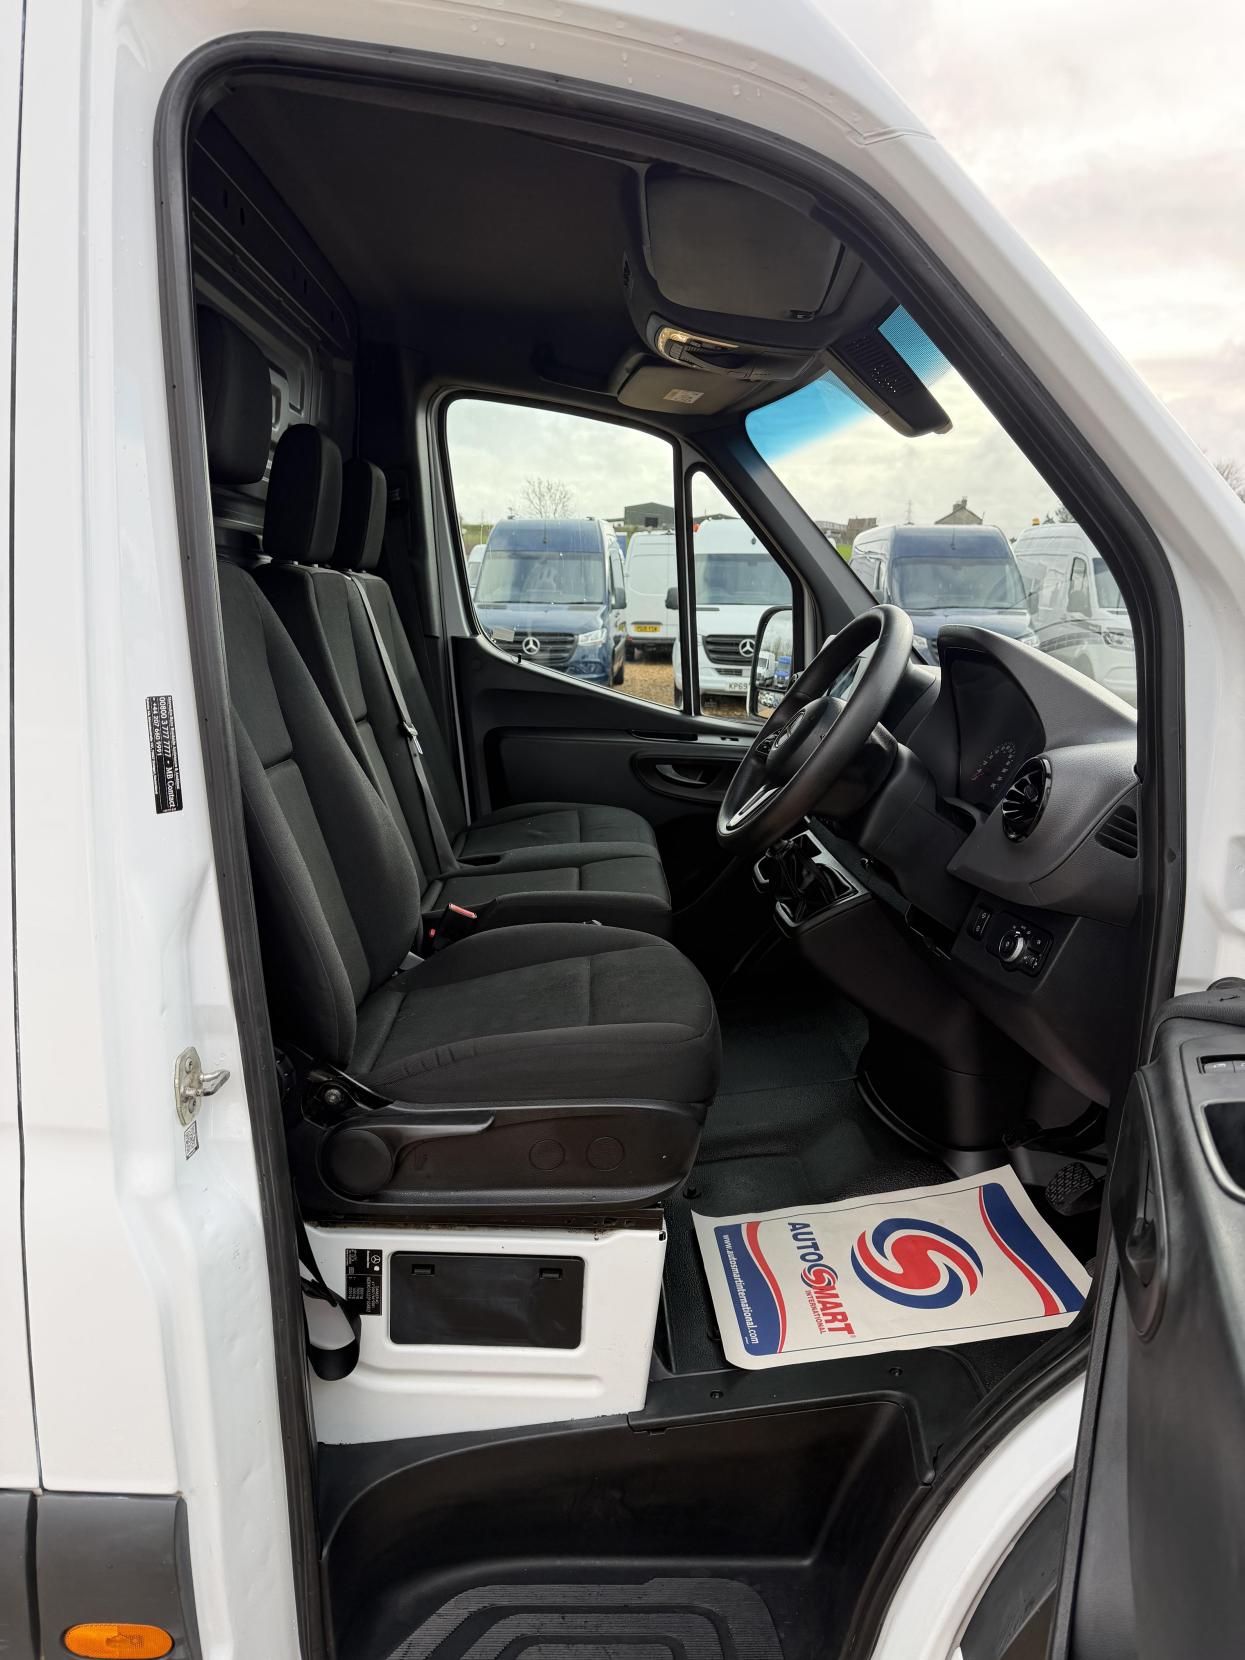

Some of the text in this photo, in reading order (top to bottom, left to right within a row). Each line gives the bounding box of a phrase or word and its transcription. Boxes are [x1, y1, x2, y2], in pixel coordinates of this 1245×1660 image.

[160, 696, 168, 719] 00800
[162, 725, 170, 739] 777
[163, 740, 171, 758] 7777
[165, 767, 174, 780] MB
[167, 780, 176, 808] Contact
[722, 1234, 759, 1344] www.autosmartinternational.com
[804, 1290, 826, 1334] INTERNATIONAL
